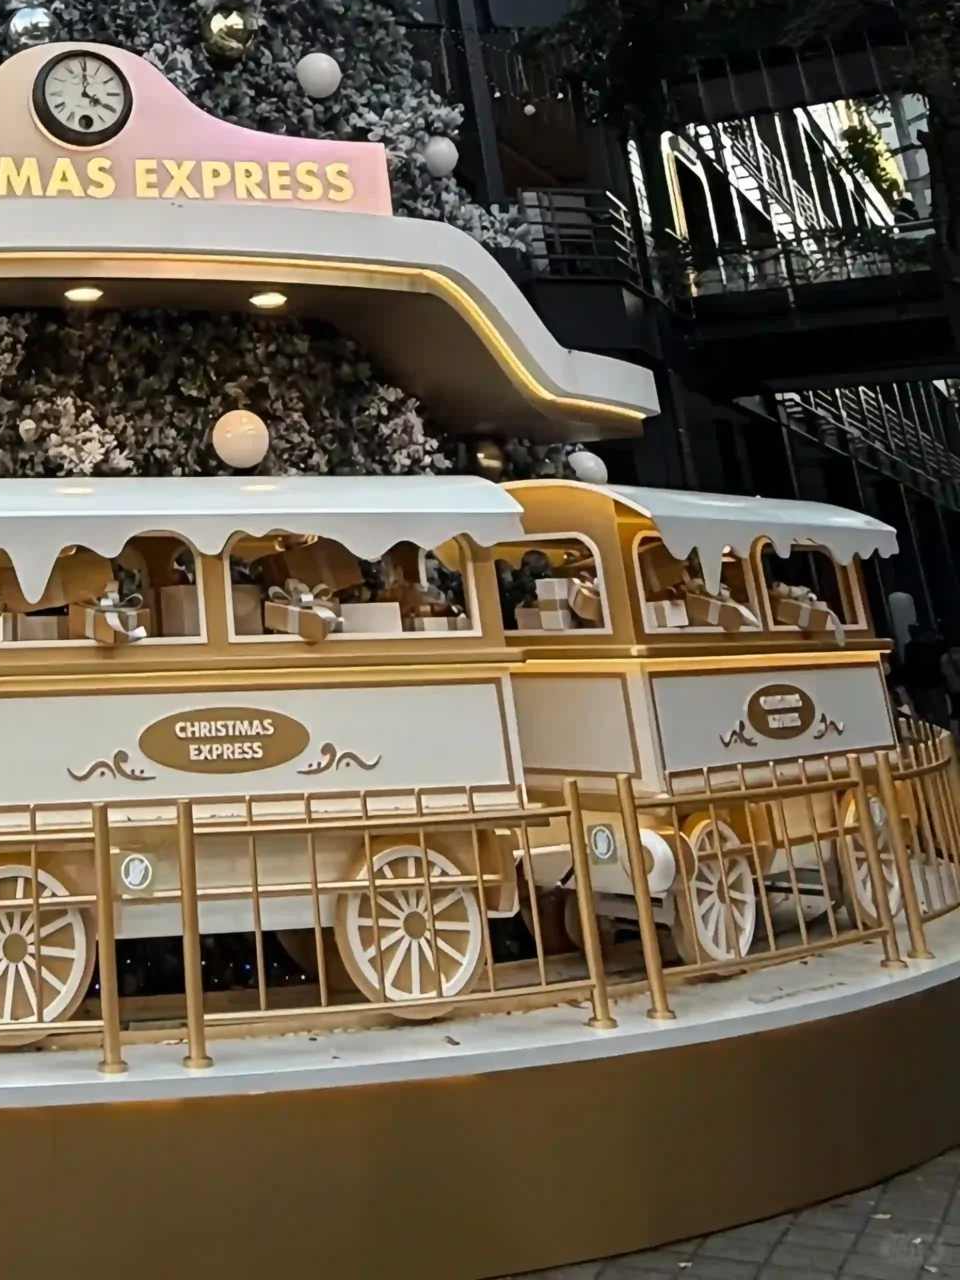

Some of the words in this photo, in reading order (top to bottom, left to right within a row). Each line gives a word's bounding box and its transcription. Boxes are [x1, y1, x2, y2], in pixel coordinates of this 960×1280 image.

[135, 160, 355, 202] EXPRESS
[174, 719, 275, 738] CHRISTMAS
[189, 742, 263, 761] EXPRESS
